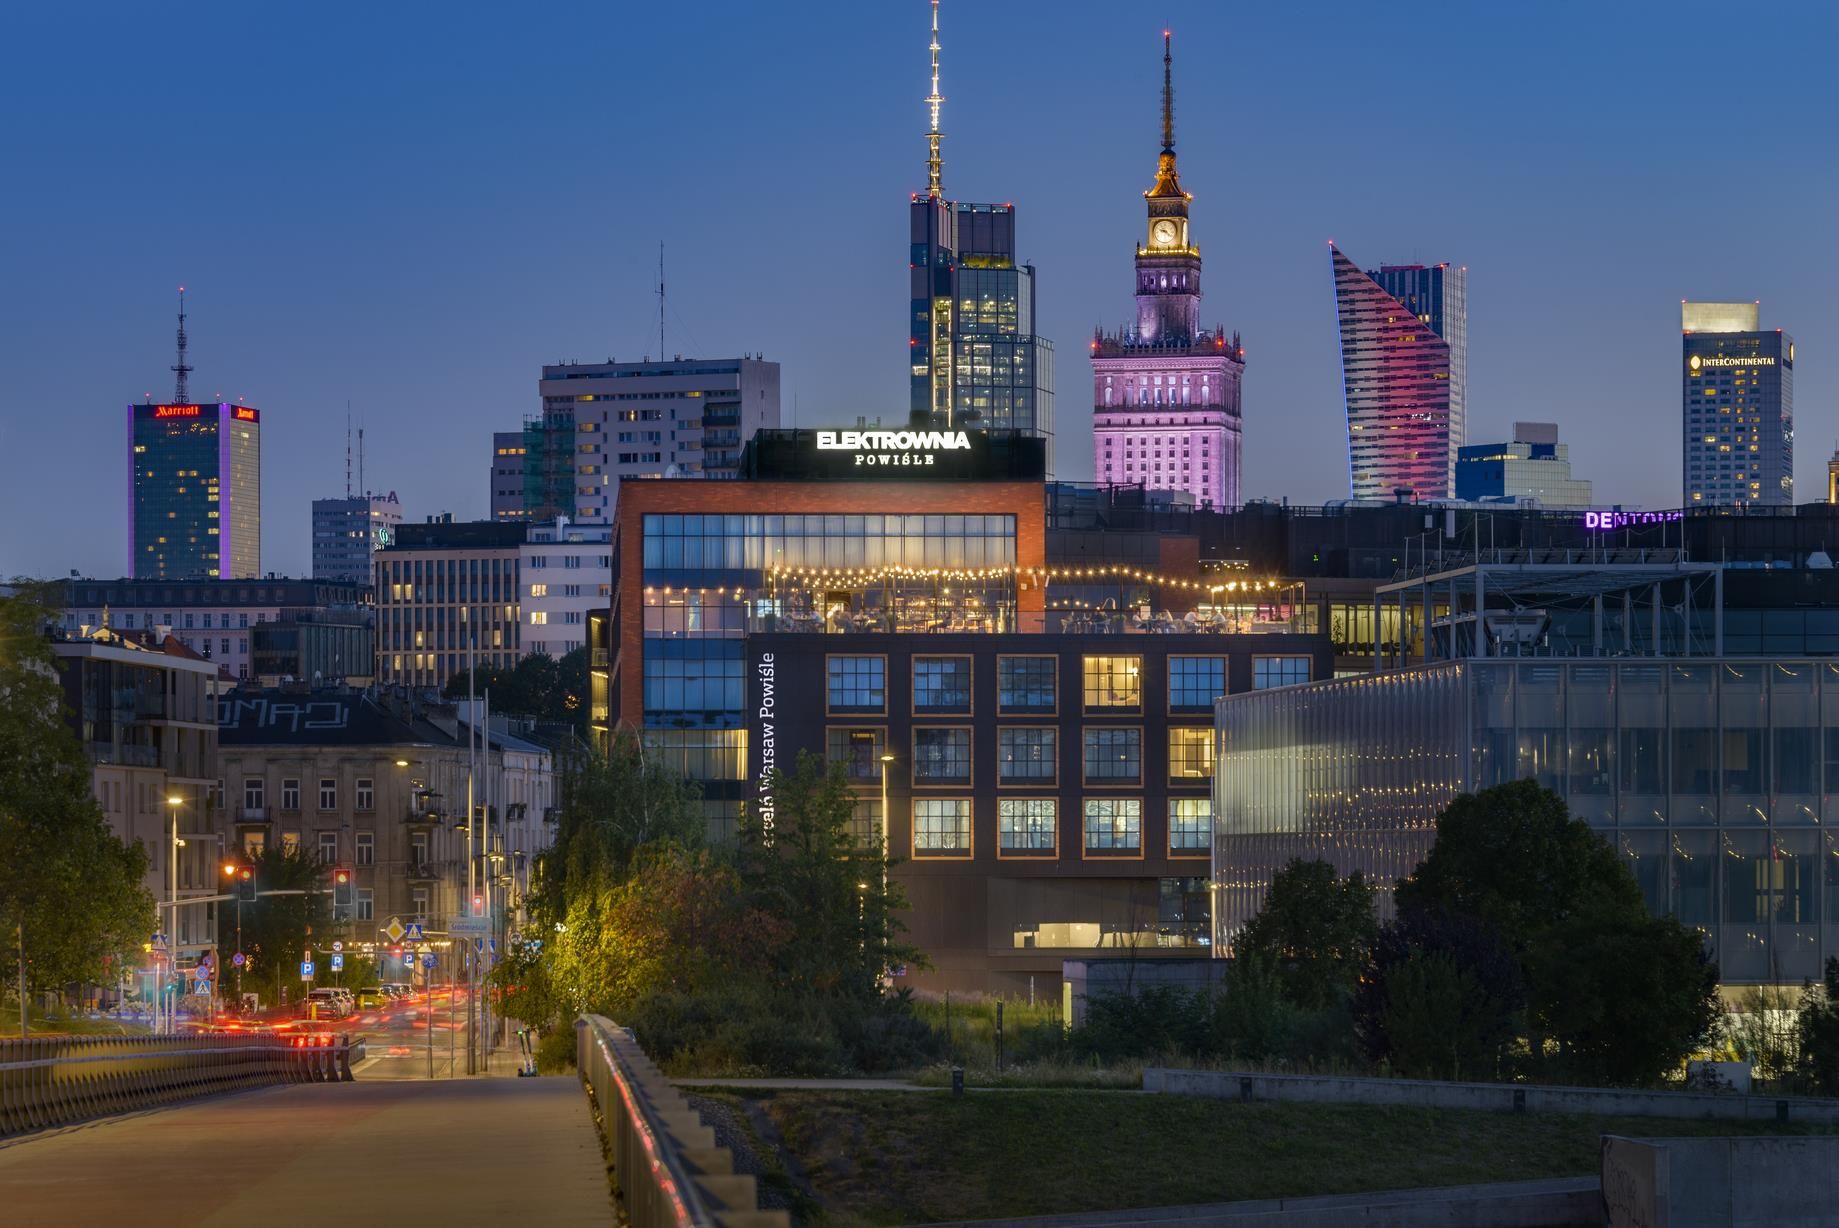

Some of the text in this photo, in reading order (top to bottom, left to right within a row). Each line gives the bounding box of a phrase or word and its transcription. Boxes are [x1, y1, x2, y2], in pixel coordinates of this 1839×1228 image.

[155, 406, 199, 417] Marriott
[816, 431, 972, 450] ELEKTROWNIA
[854, 452, 935, 465] POWIŚLE
[758, 652, 775, 719] Powiśle
[759, 722, 775, 792] Warsaw
[303, 963, 312, 973] P
